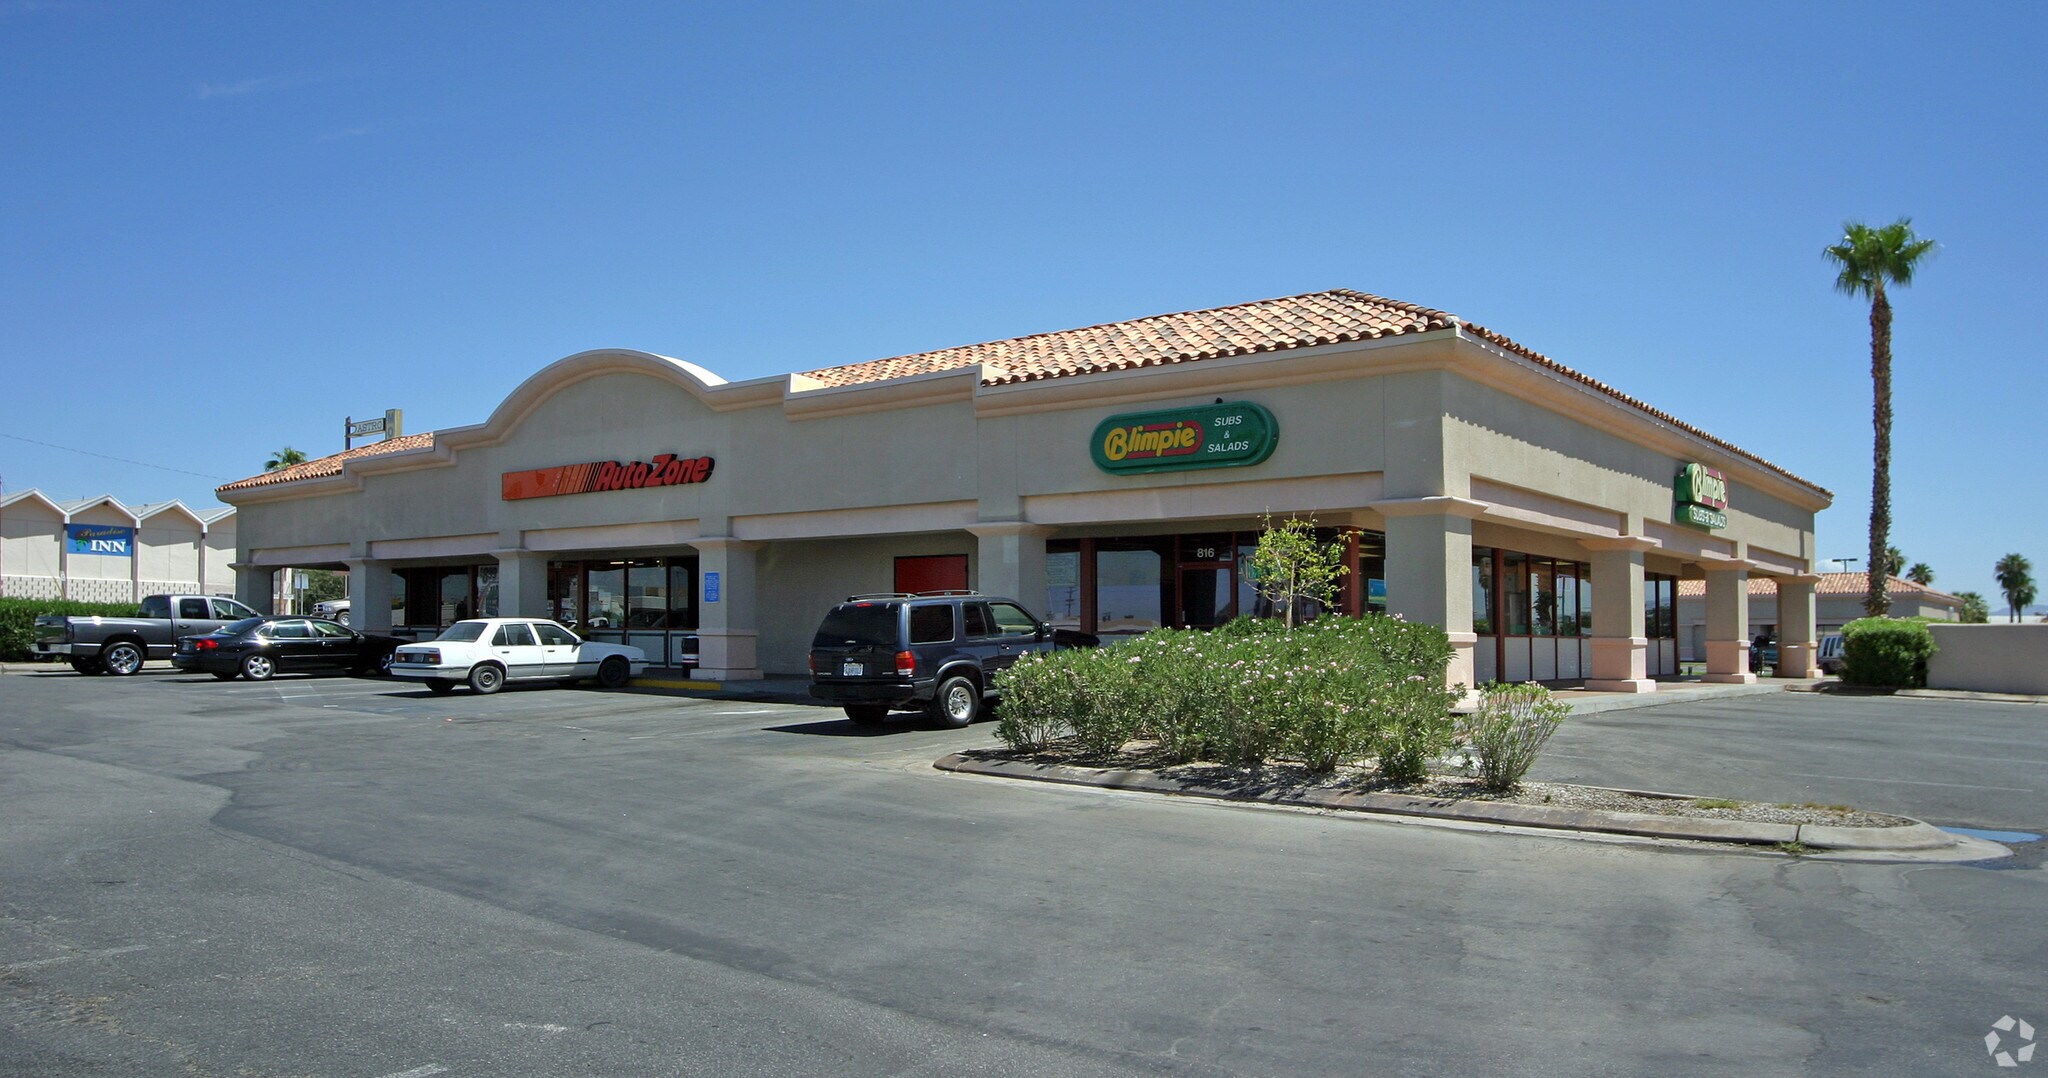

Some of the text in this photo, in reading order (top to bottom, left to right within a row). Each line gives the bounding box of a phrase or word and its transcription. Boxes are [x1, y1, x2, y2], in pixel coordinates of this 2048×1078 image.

[357, 421, 382, 433] ASTRO
[1214, 415, 1243, 427] SUBS
[1223, 430, 1230, 439] &
[1104, 422, 1196, 462] Blimpie
[1207, 440, 1249, 453] SALADS
[594, 454, 715, 491] AutoZone
[1692, 463, 1726, 507] Blimpie
[90, 539, 127, 553] INN
[1196, 547, 1215, 558] 816
